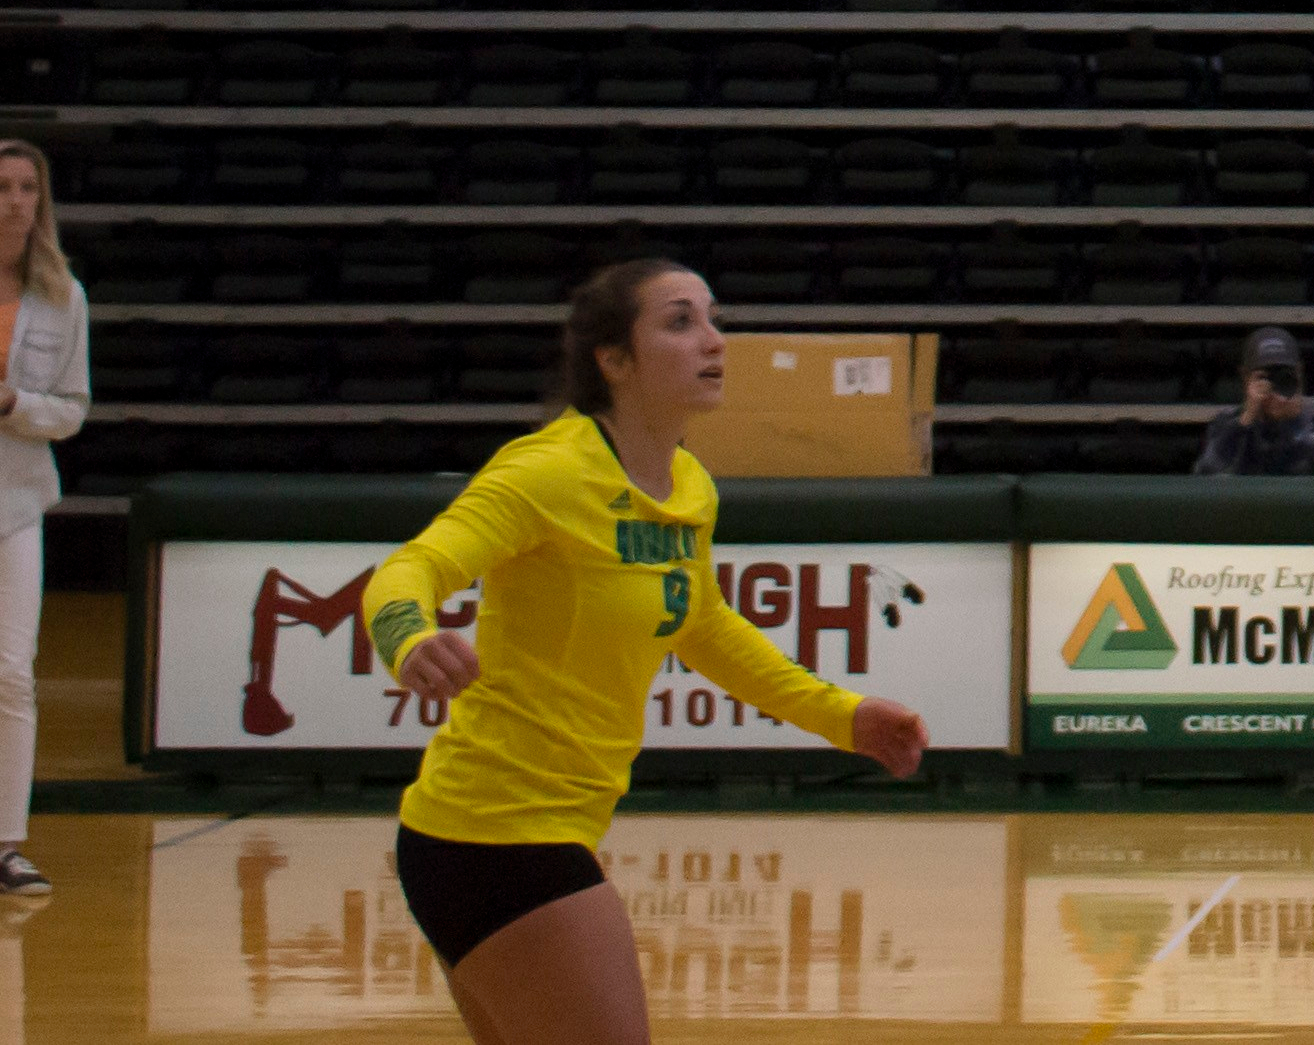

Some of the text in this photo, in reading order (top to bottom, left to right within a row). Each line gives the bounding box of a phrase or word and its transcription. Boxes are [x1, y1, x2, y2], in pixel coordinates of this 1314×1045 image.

[1167, 566, 1266, 596] Roofing
[653, 567, 691, 638] 9
[1053, 714, 1148, 733] EUREKA
[1182, 714, 1306, 733] CRESCENT
